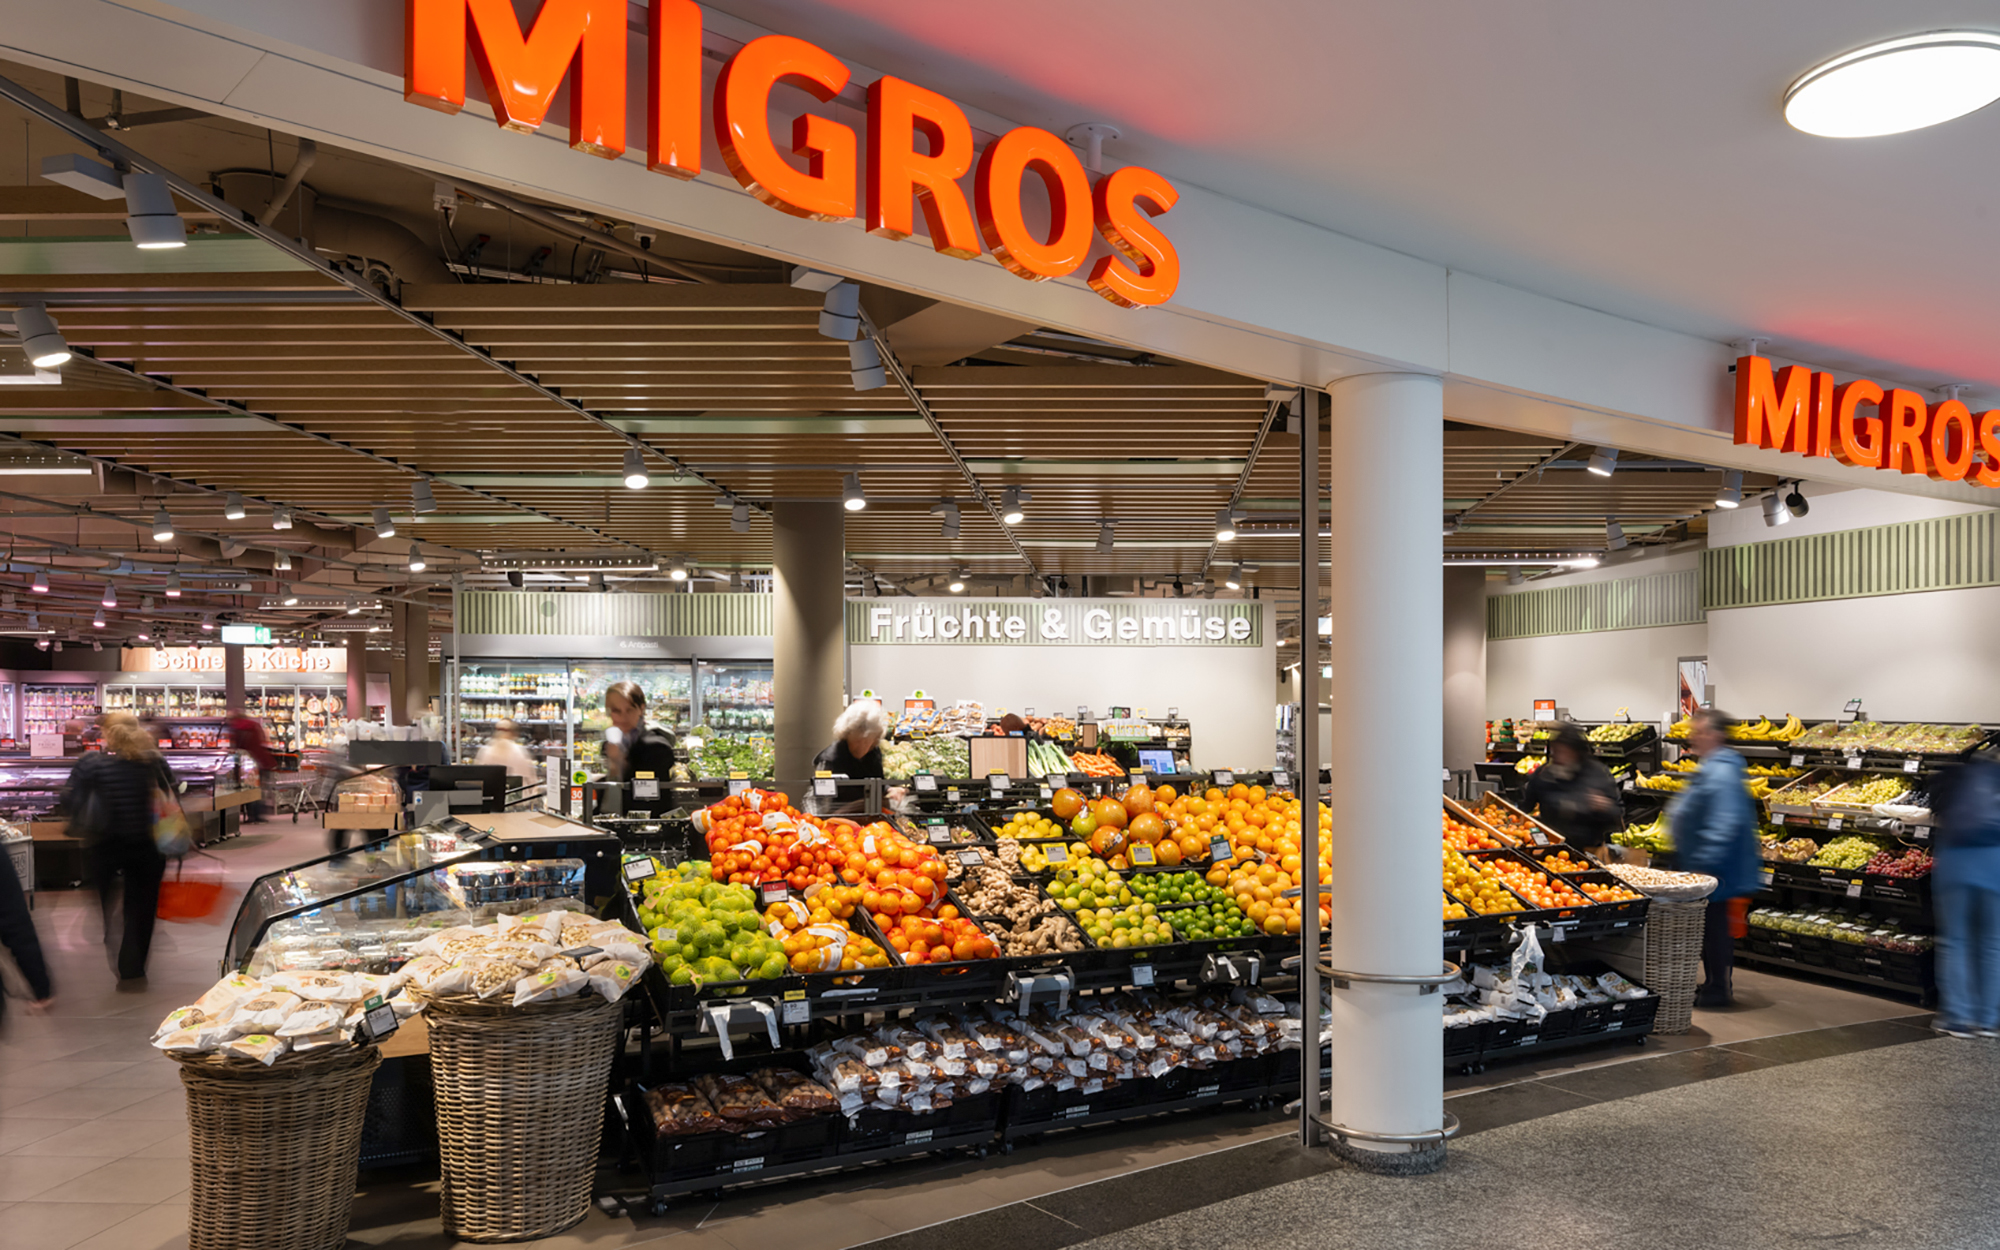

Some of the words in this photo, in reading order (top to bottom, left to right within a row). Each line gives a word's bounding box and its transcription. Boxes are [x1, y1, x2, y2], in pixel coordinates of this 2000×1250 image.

[404, 0, 1180, 309] MIGROS
[870, 606, 1027, 639] Früchte
[1041, 607, 1070, 640] &
[1083, 607, 1252, 640] Gemüse
[628, 640, 659, 649] Antipasti
[155, 649, 253, 670] Schnee
[260, 650, 331, 670] Küche
